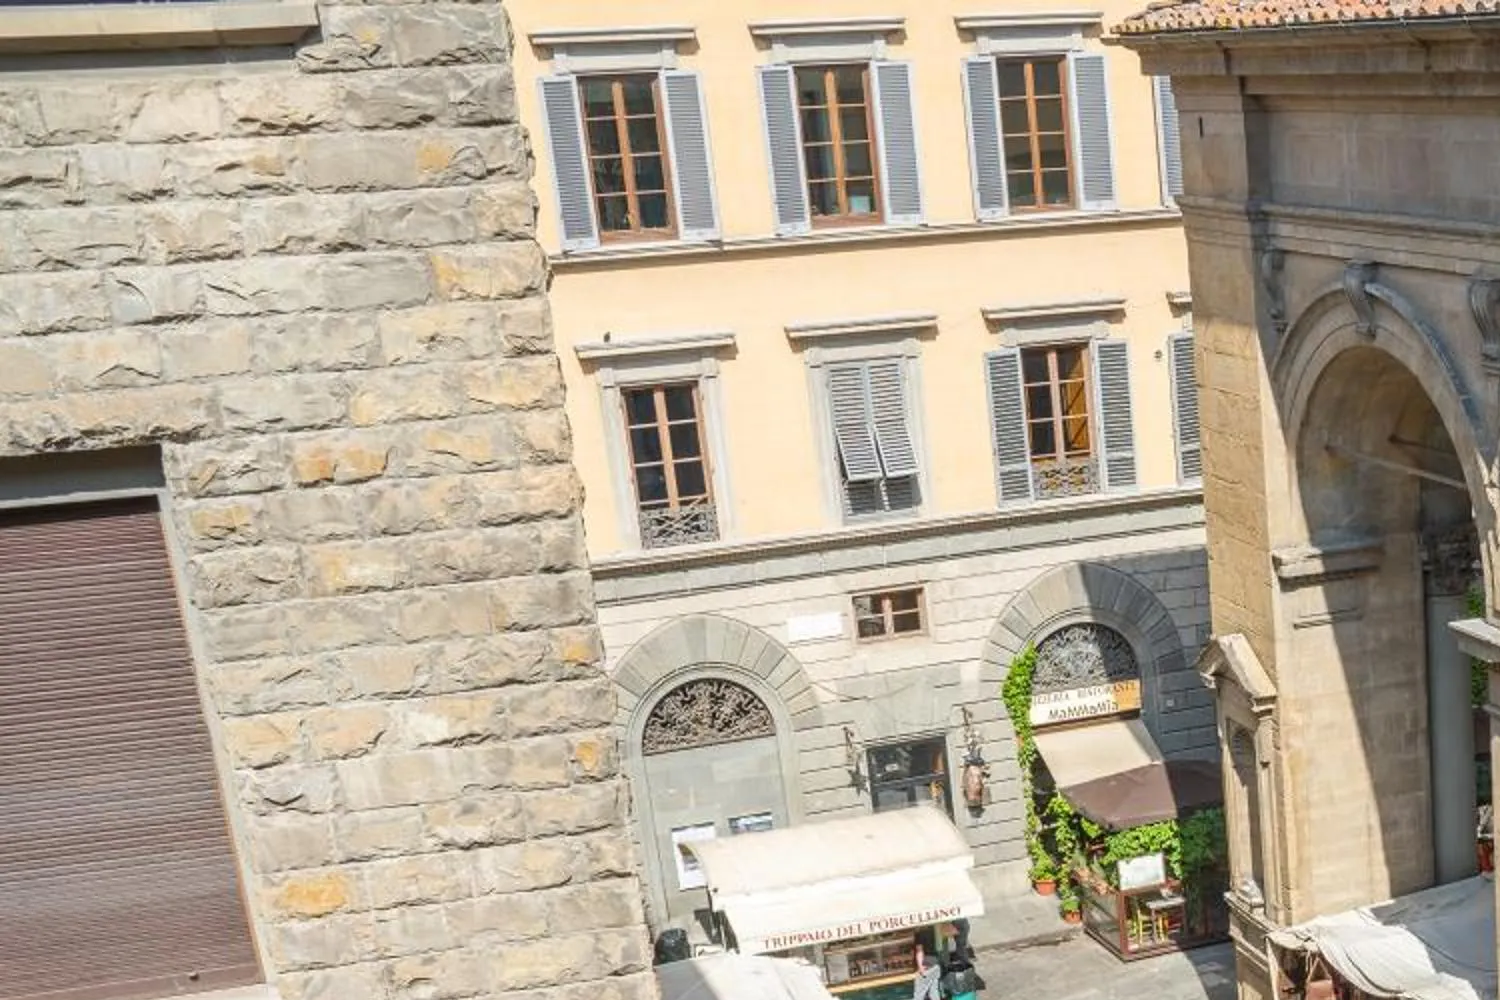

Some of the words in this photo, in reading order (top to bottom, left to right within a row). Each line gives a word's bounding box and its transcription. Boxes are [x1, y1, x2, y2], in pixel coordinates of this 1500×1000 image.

[763, 930, 833, 949] TRIPPAIO
[837, 924, 863, 937] DEL
[869, 906, 961, 931] PORCELLINO
